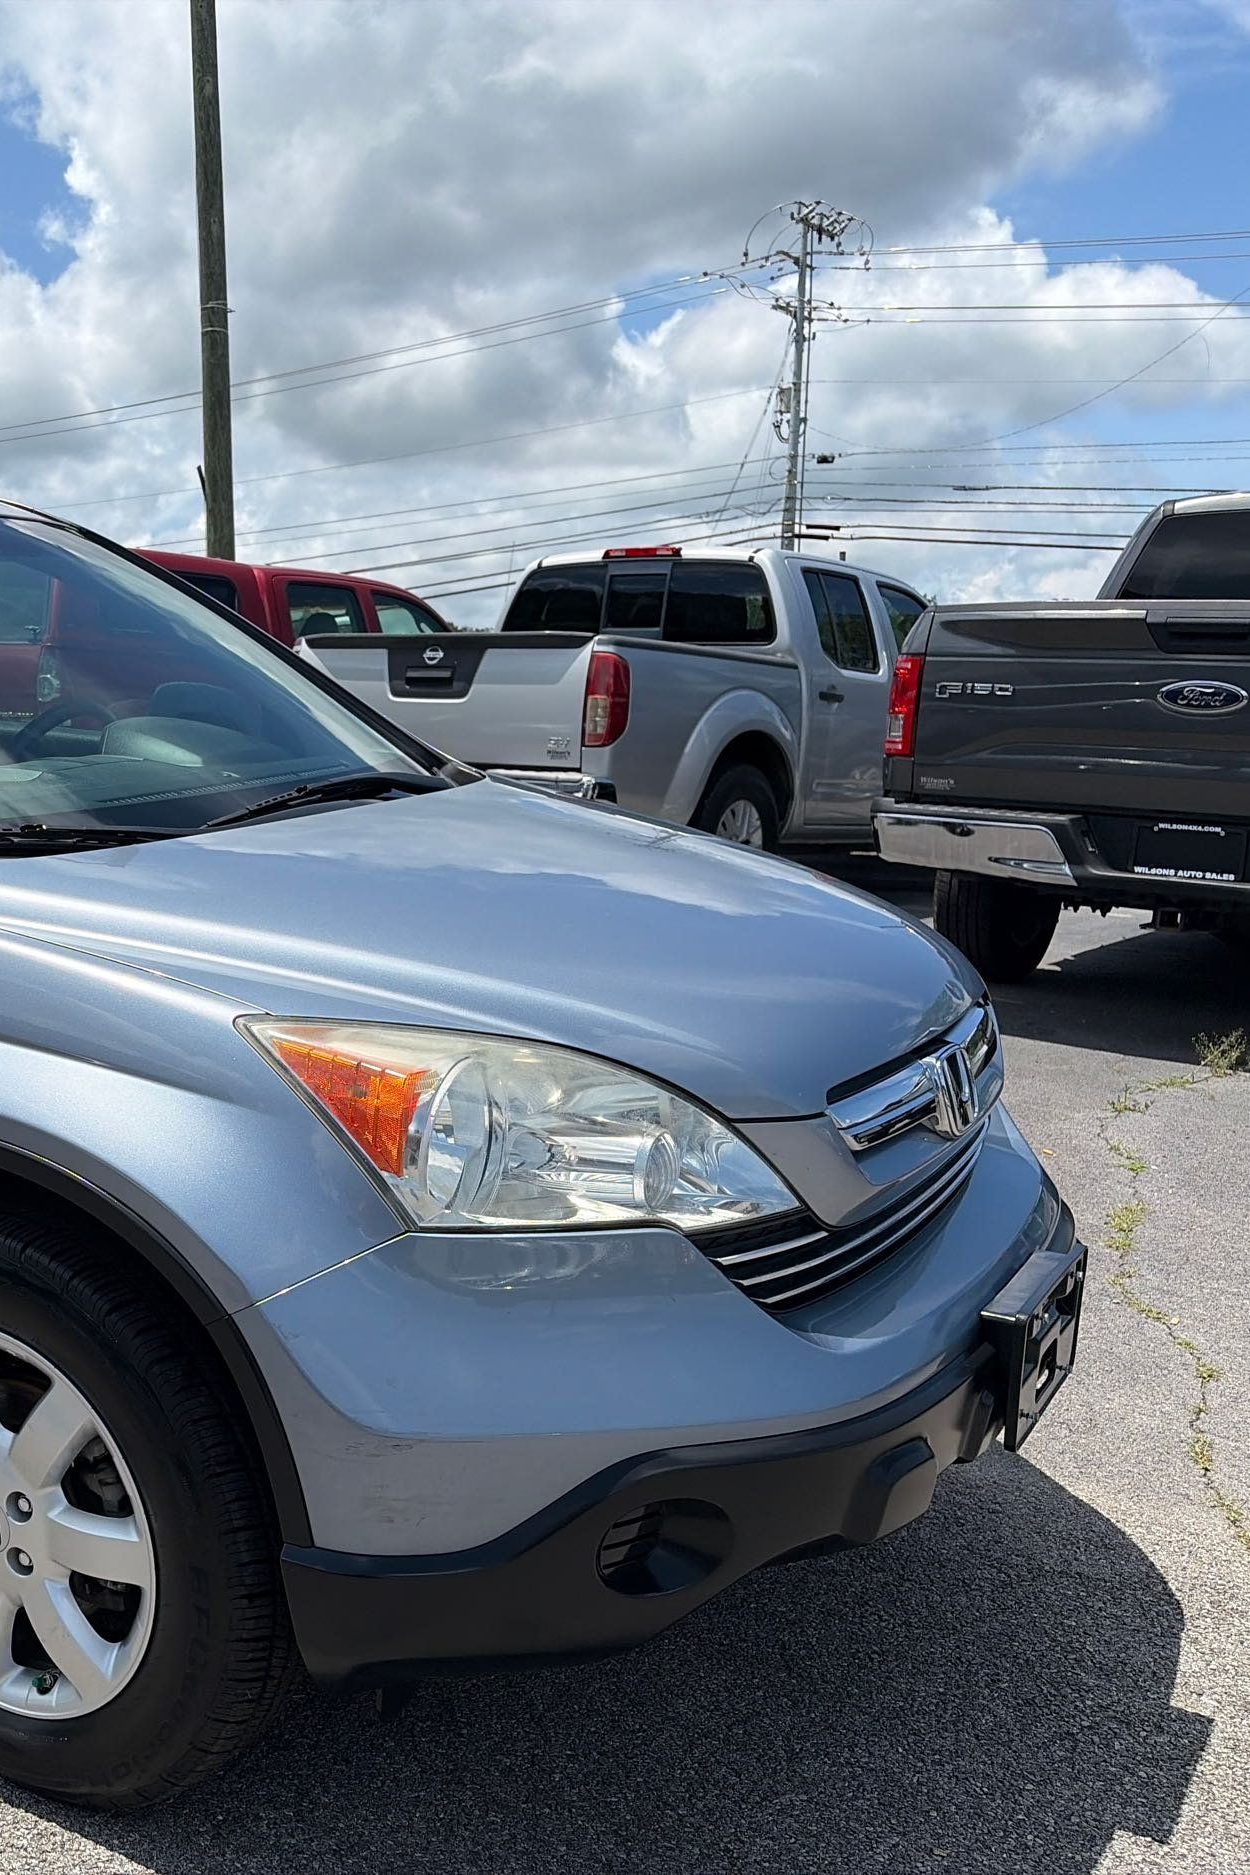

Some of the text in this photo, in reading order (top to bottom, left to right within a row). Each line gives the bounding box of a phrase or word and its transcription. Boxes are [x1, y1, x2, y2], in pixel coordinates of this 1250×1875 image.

[1177, 686, 1227, 706] Ford
[1134, 865, 1236, 881] WILSONS AUTO SALES
